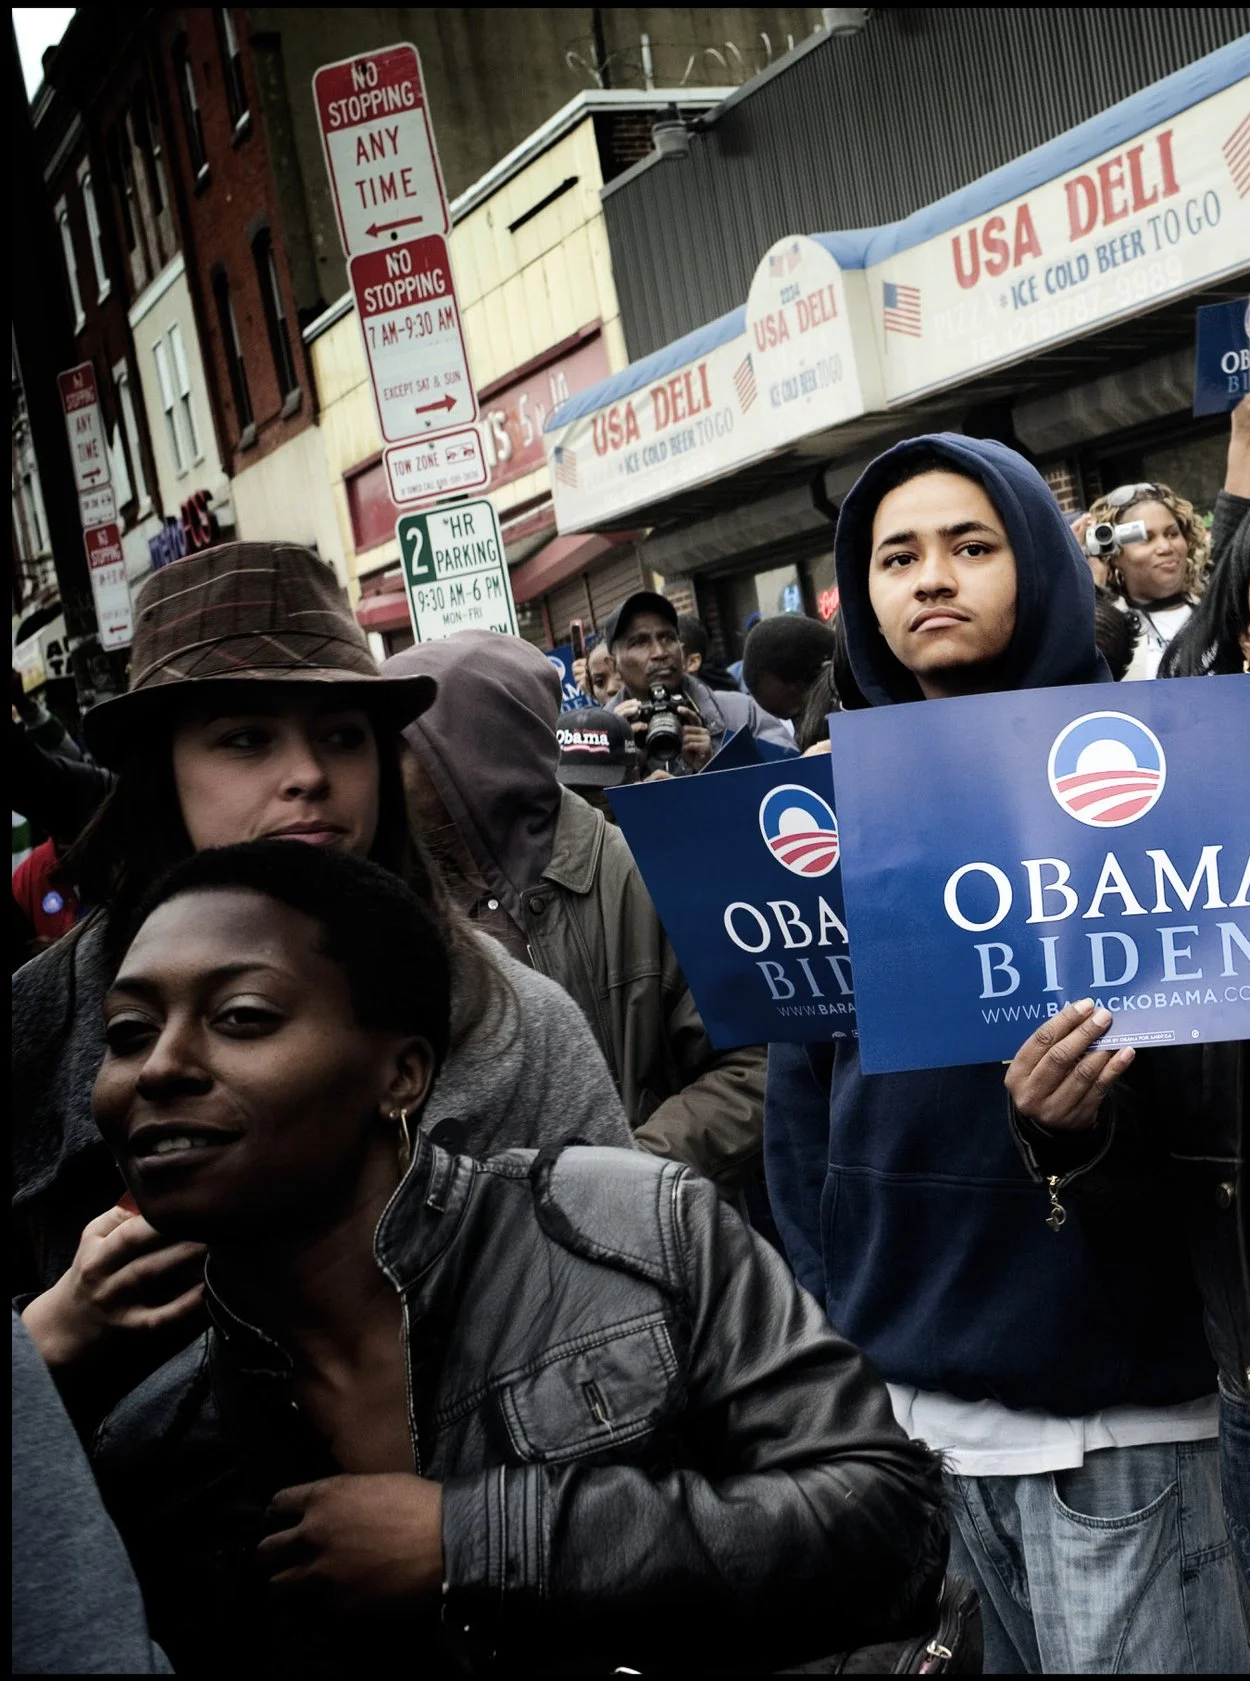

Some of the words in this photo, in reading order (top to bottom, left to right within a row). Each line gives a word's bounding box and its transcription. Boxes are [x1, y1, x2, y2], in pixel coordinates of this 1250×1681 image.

[351, 61, 378, 91] NO
[328, 81, 415, 126] STOPPING
[356, 125, 399, 166] ANY
[355, 167, 417, 209] TIME
[952, 202, 1042, 290] USA
[1064, 128, 1180, 243] DELI
[385, 249, 412, 278] NO
[1011, 275, 1040, 310] ICE
[1045, 253, 1089, 295] COLD
[1094, 228, 1145, 274] BEER
[1148, 209, 1180, 251] TO
[1186, 189, 1221, 235] GO
[364, 268, 445, 312] STOPPING
[369, 327, 376, 350] 7
[439, 306, 455, 331] AM
[753, 310, 790, 352] USA
[796, 283, 838, 334] DELI
[1221, 349, 1250, 374] OB
[383, 382, 414, 401] EXCEPT
[416, 378, 430, 392] SAT
[434, 376, 441, 388] &
[444, 370, 461, 385] SUN
[592, 400, 640, 457] USA
[651, 363, 712, 431] DELI
[394, 460, 412, 477] TOW
[416, 452, 440, 472] ZONE
[642, 440, 667, 466] COLD
[669, 430, 698, 459] BEER
[450, 513, 475, 538] HR
[406, 527, 429, 576] 2
[436, 538, 497, 573] PARKING
[418, 587, 445, 612] 9:30
[486, 575, 502, 600] PM
[443, 607, 483, 624] MON-FRI
[556, 728, 610, 747] Obama
[723, 896, 849, 953] OBA
[756, 955, 856, 1000] BID
[777, 1002, 857, 1017] WWW.BARA
